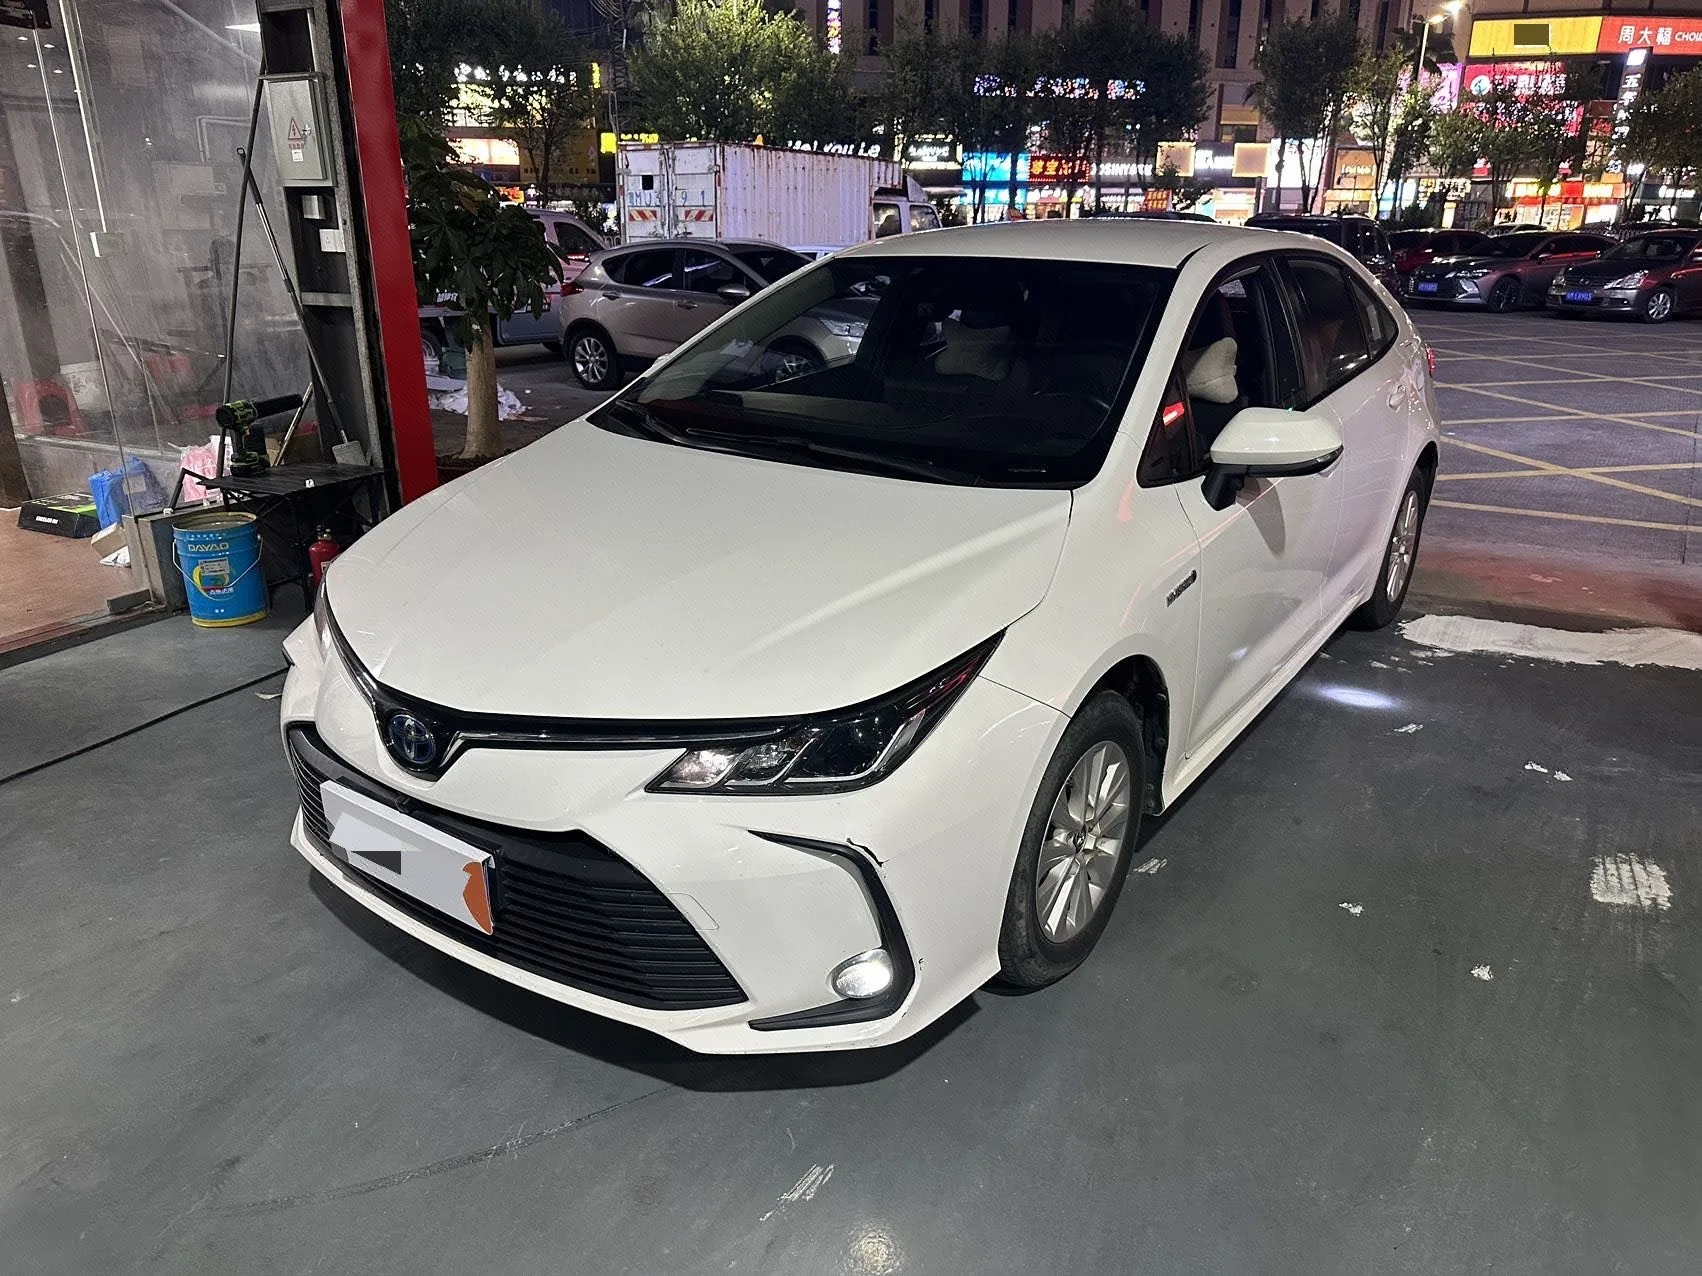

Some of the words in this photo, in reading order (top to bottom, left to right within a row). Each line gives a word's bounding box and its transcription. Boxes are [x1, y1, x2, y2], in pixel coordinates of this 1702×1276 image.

[1618, 25, 1673, 46] 周大福
[188, 542, 229, 552] DAYAO
